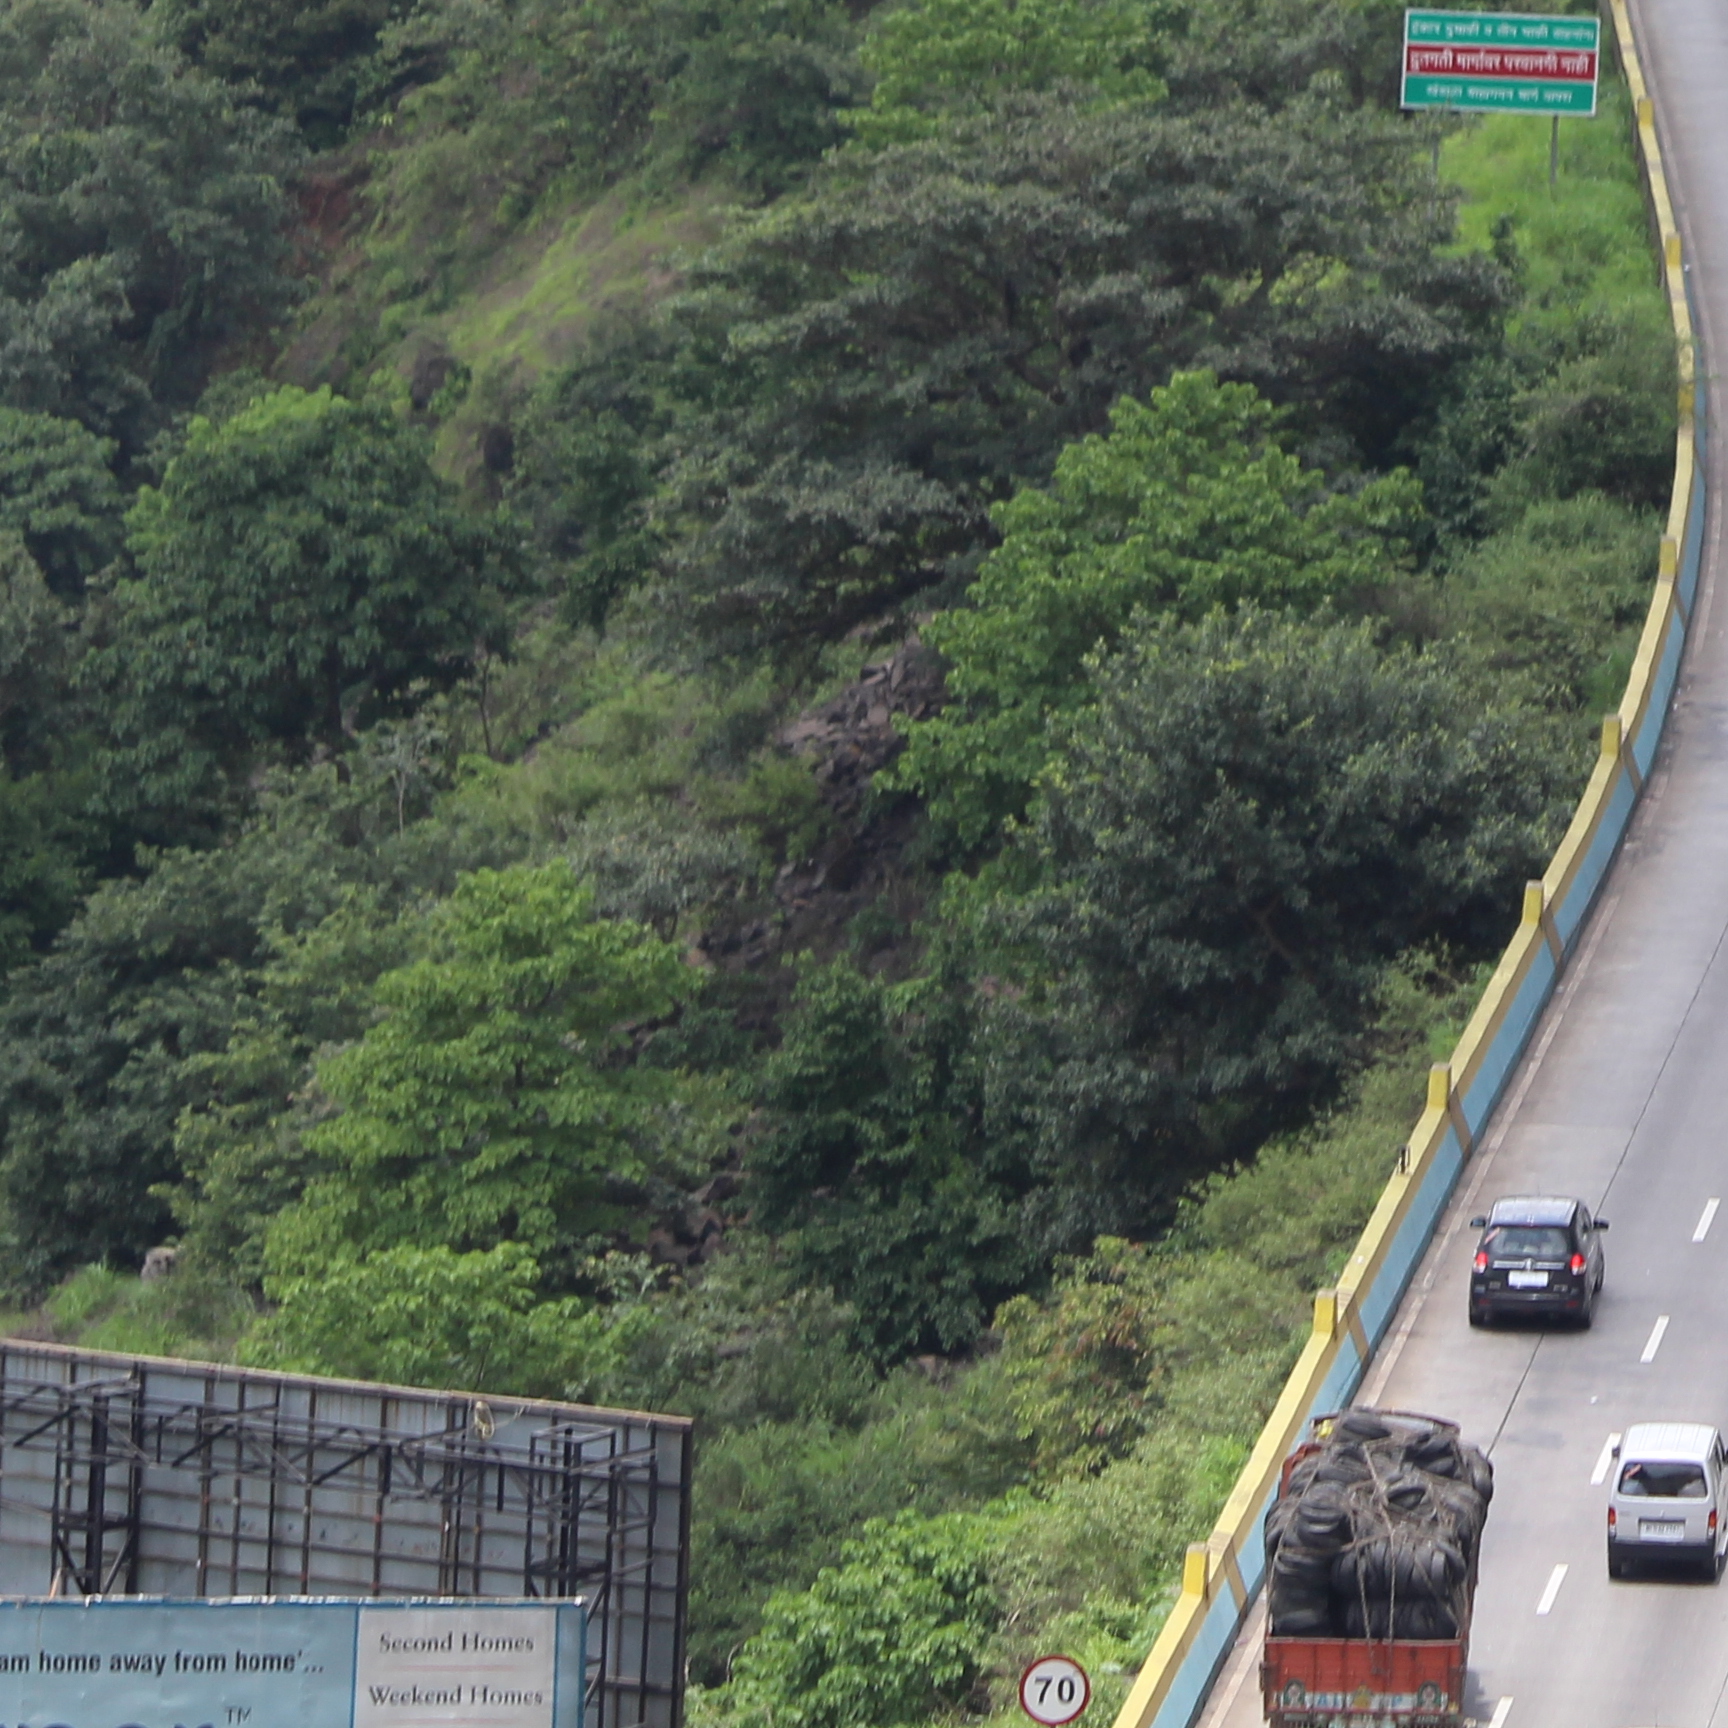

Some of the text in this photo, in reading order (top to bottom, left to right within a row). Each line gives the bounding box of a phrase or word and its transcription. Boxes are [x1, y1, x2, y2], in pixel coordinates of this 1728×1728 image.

[379, 1631, 535, 1654] Second Homes
[39, 1649, 100, 1673] home
[110, 1653, 166, 1677] away
[174, 1649, 226, 1673] from
[368, 1684, 544, 1707] Weekend Homes
[1034, 1675, 1076, 1706] 70
[224, 1705, 251, 1726] TM
